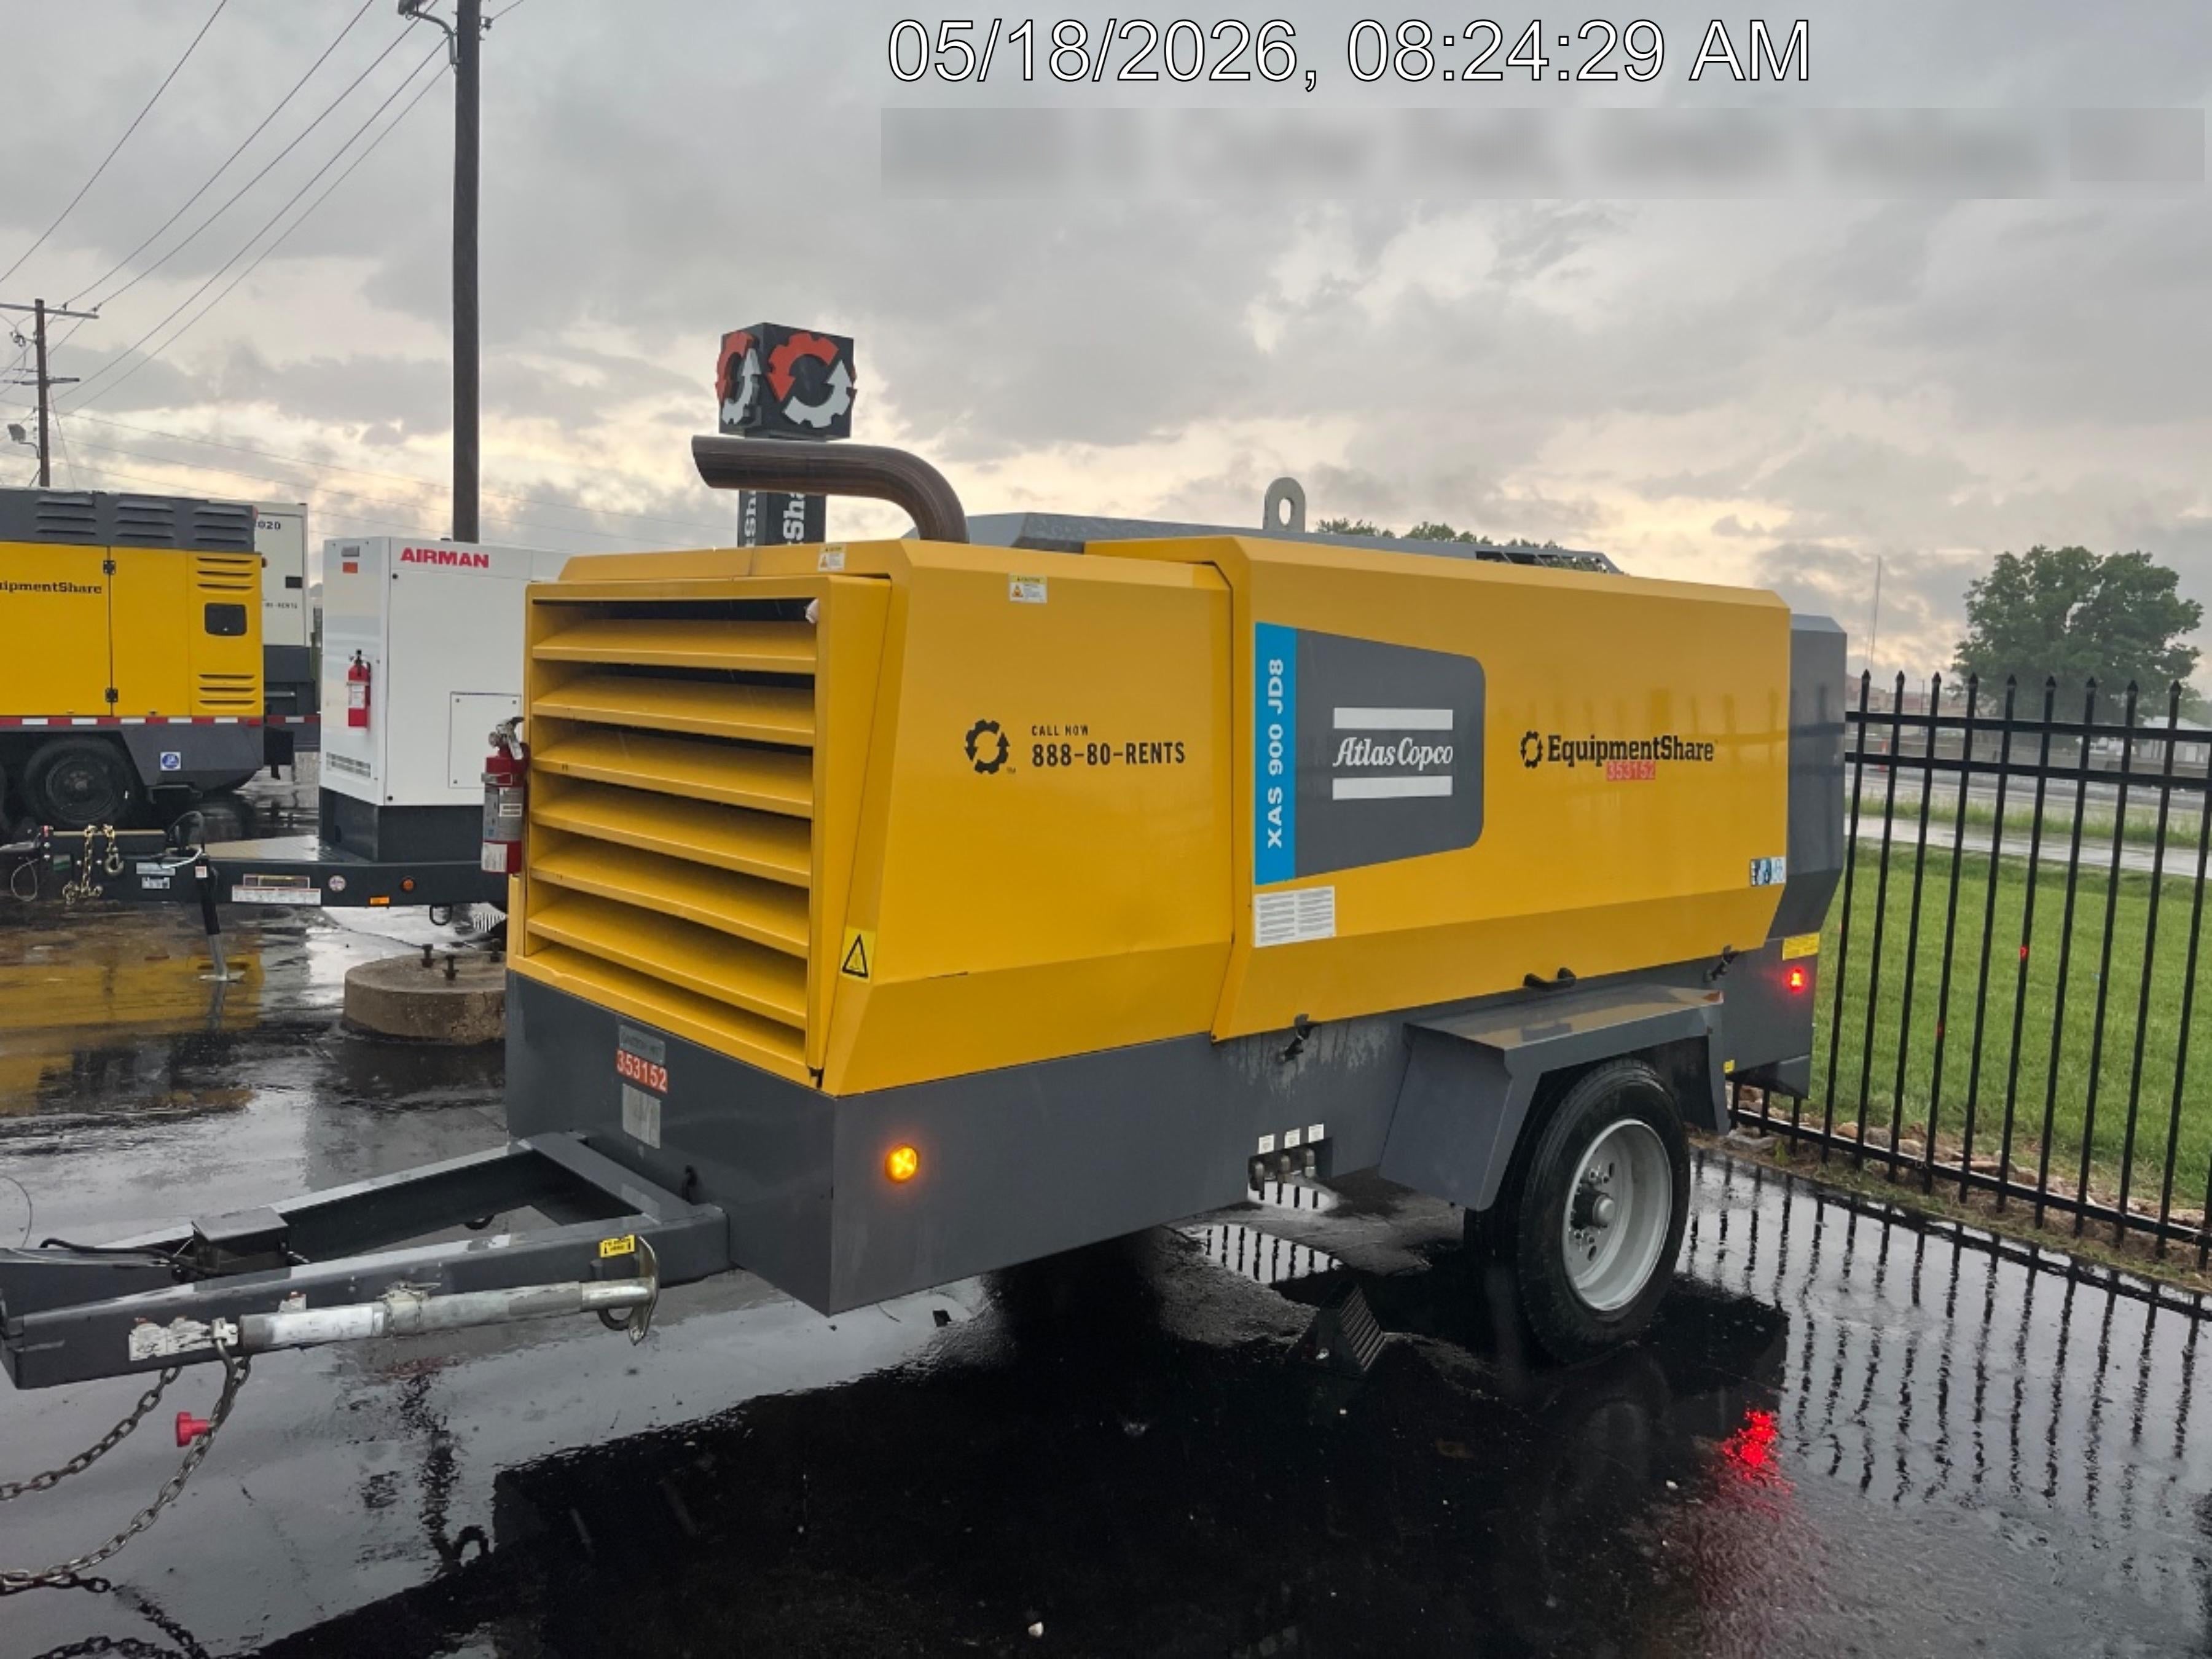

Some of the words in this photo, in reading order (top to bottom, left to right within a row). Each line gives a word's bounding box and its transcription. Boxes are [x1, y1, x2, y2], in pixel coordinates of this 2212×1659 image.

[400, 547, 489, 568] AIRMAN
[1268, 659, 1284, 715] JD8
[1032, 725, 1059, 736] CALL
[1065, 724, 1089, 735] NOW
[1032, 741, 1186, 767] 888-80-RENTS
[1268, 724, 1284, 776] 900
[1332, 737, 1396, 767] Atlas
[1397, 737, 1453, 771] Copco
[1548, 734, 1714, 767] EquipmentShare
[1607, 762, 1655, 780] 353152
[1268, 786, 1284, 849] XAS
[617, 1049, 668, 1093] 353152
